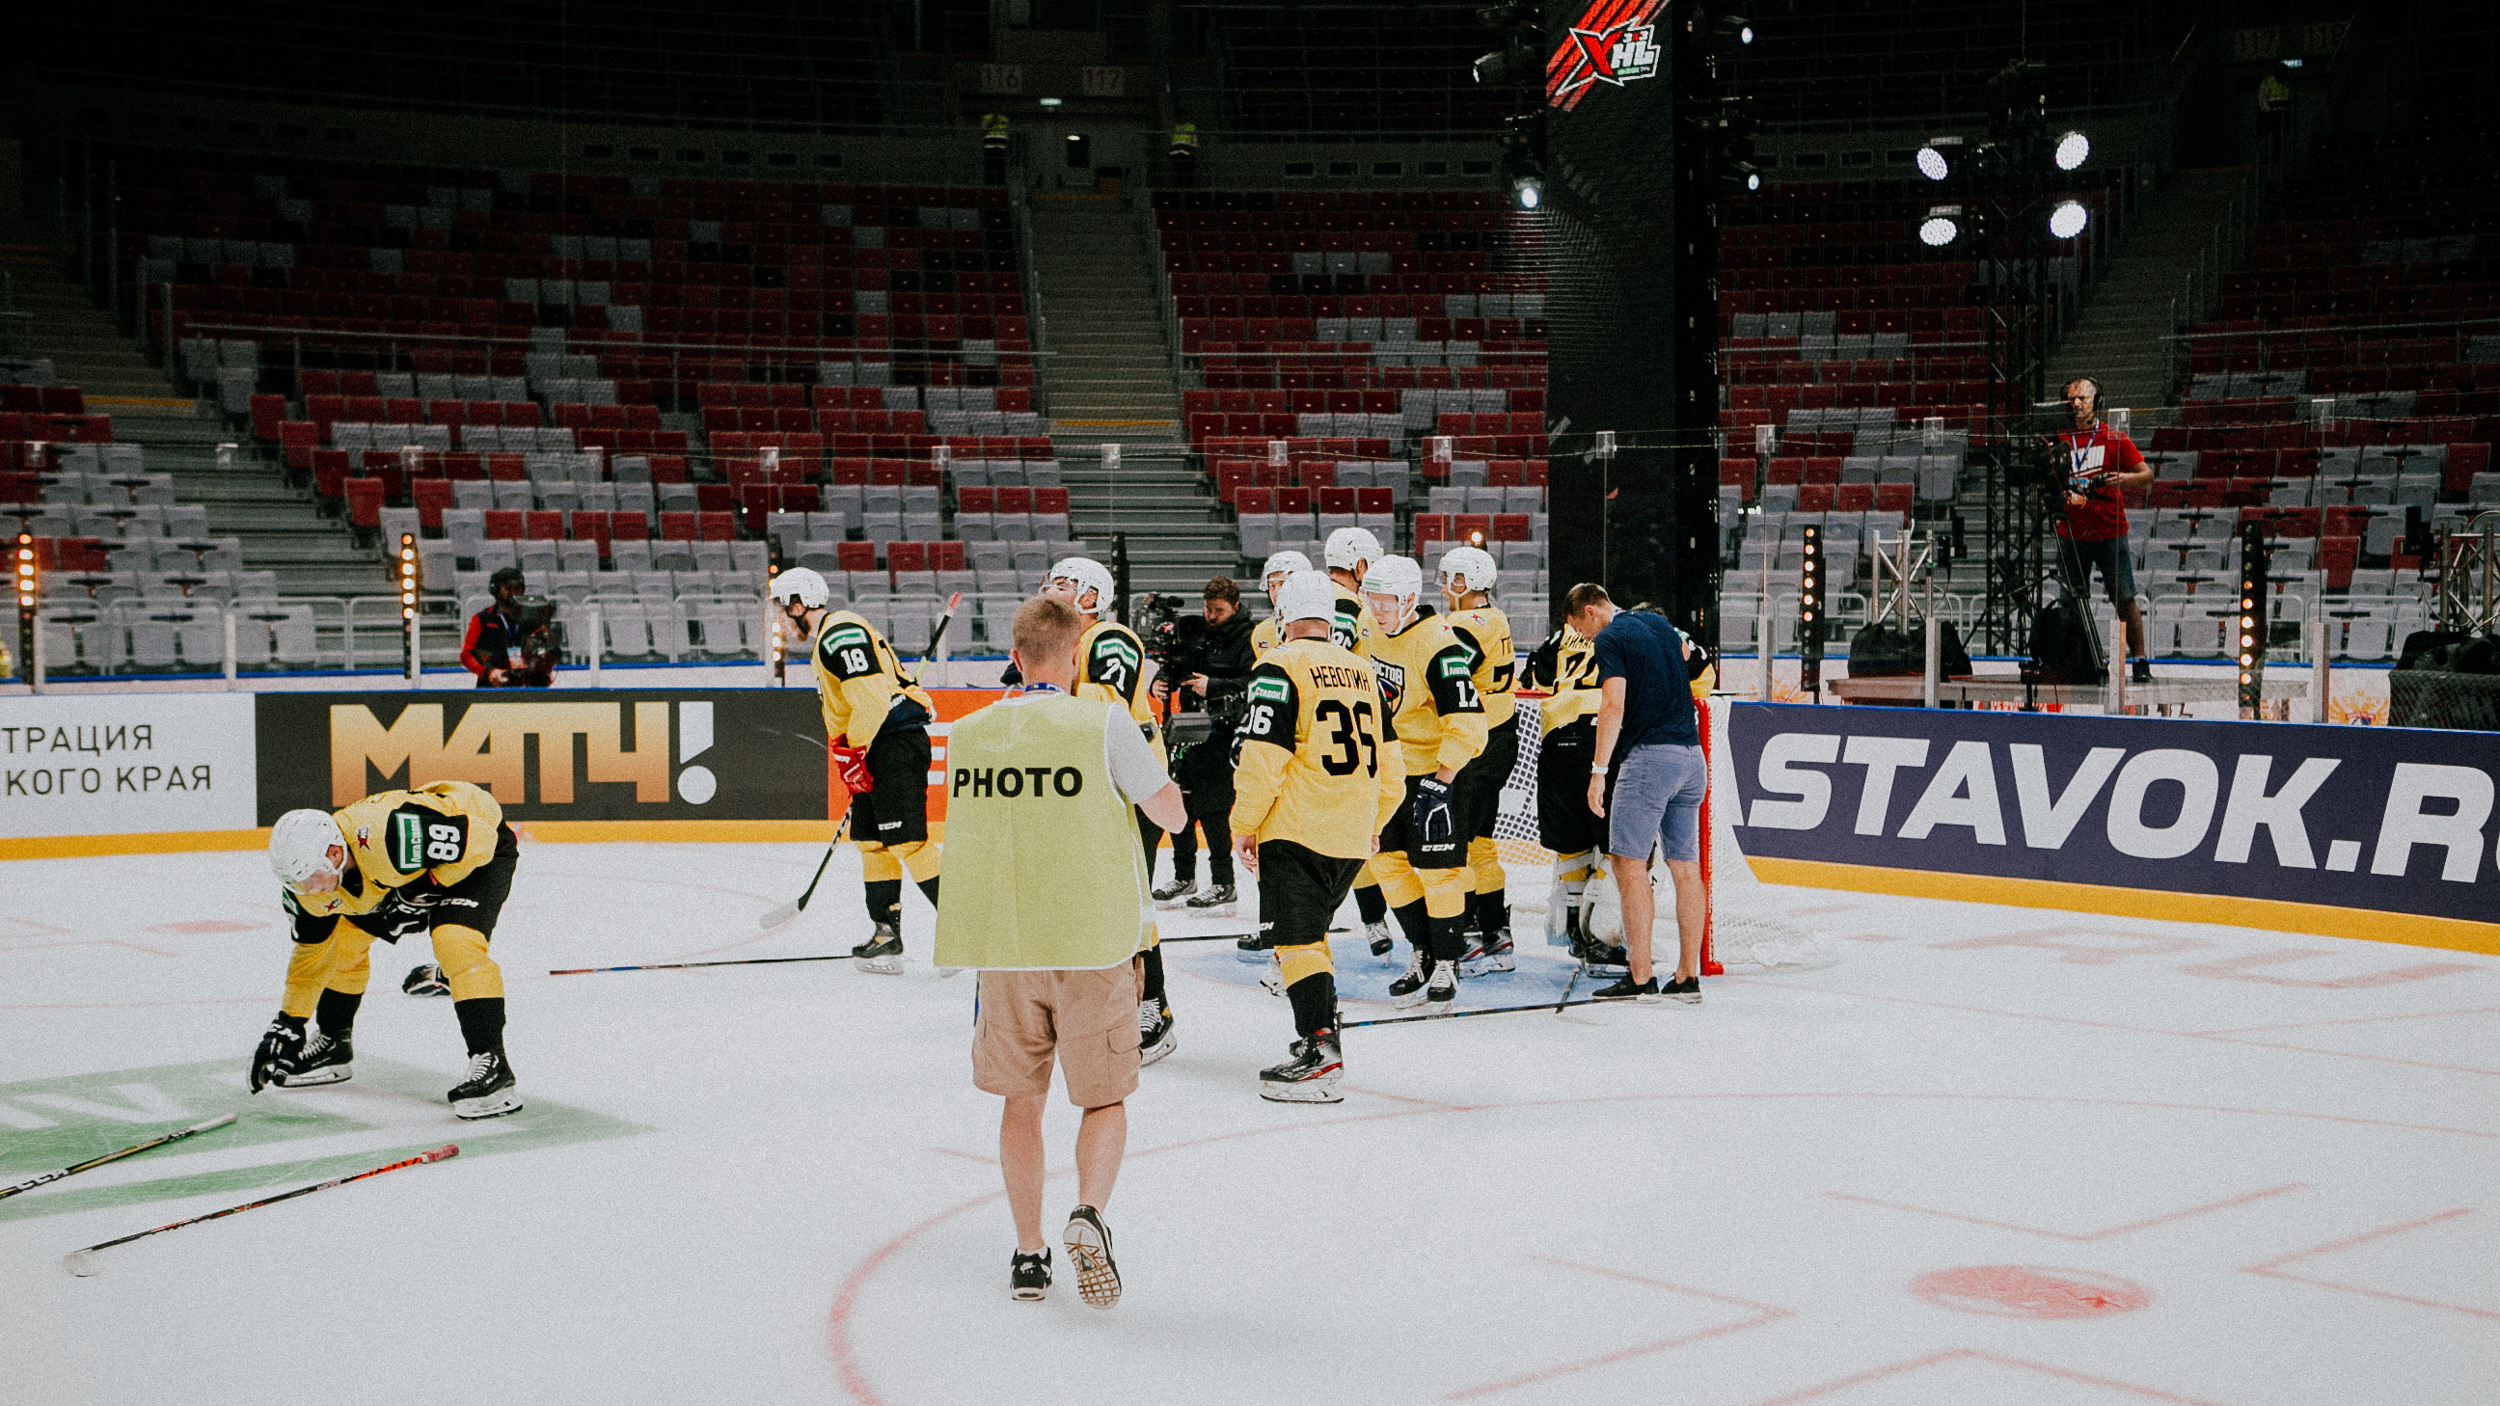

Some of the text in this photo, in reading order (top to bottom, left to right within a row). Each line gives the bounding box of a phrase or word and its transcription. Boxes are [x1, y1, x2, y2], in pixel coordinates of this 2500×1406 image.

[1084, 68, 1122, 91] 117
[841, 648, 869, 674] 18
[1100, 657, 1126, 692] 21
[1246, 704, 1275, 735] 6
[1, 724, 152, 758] ТРАЦИЯ
[329, 701, 717, 808] МАТЧ!
[1316, 699, 1378, 779] 36
[6, 765, 211, 797] КОГО КРАЯ
[953, 766, 1083, 798] PHOTO
[1732, 731, 2500, 884] STAVOK.R
[427, 823, 460, 861] 89
[1421, 843, 1456, 853] CCM
